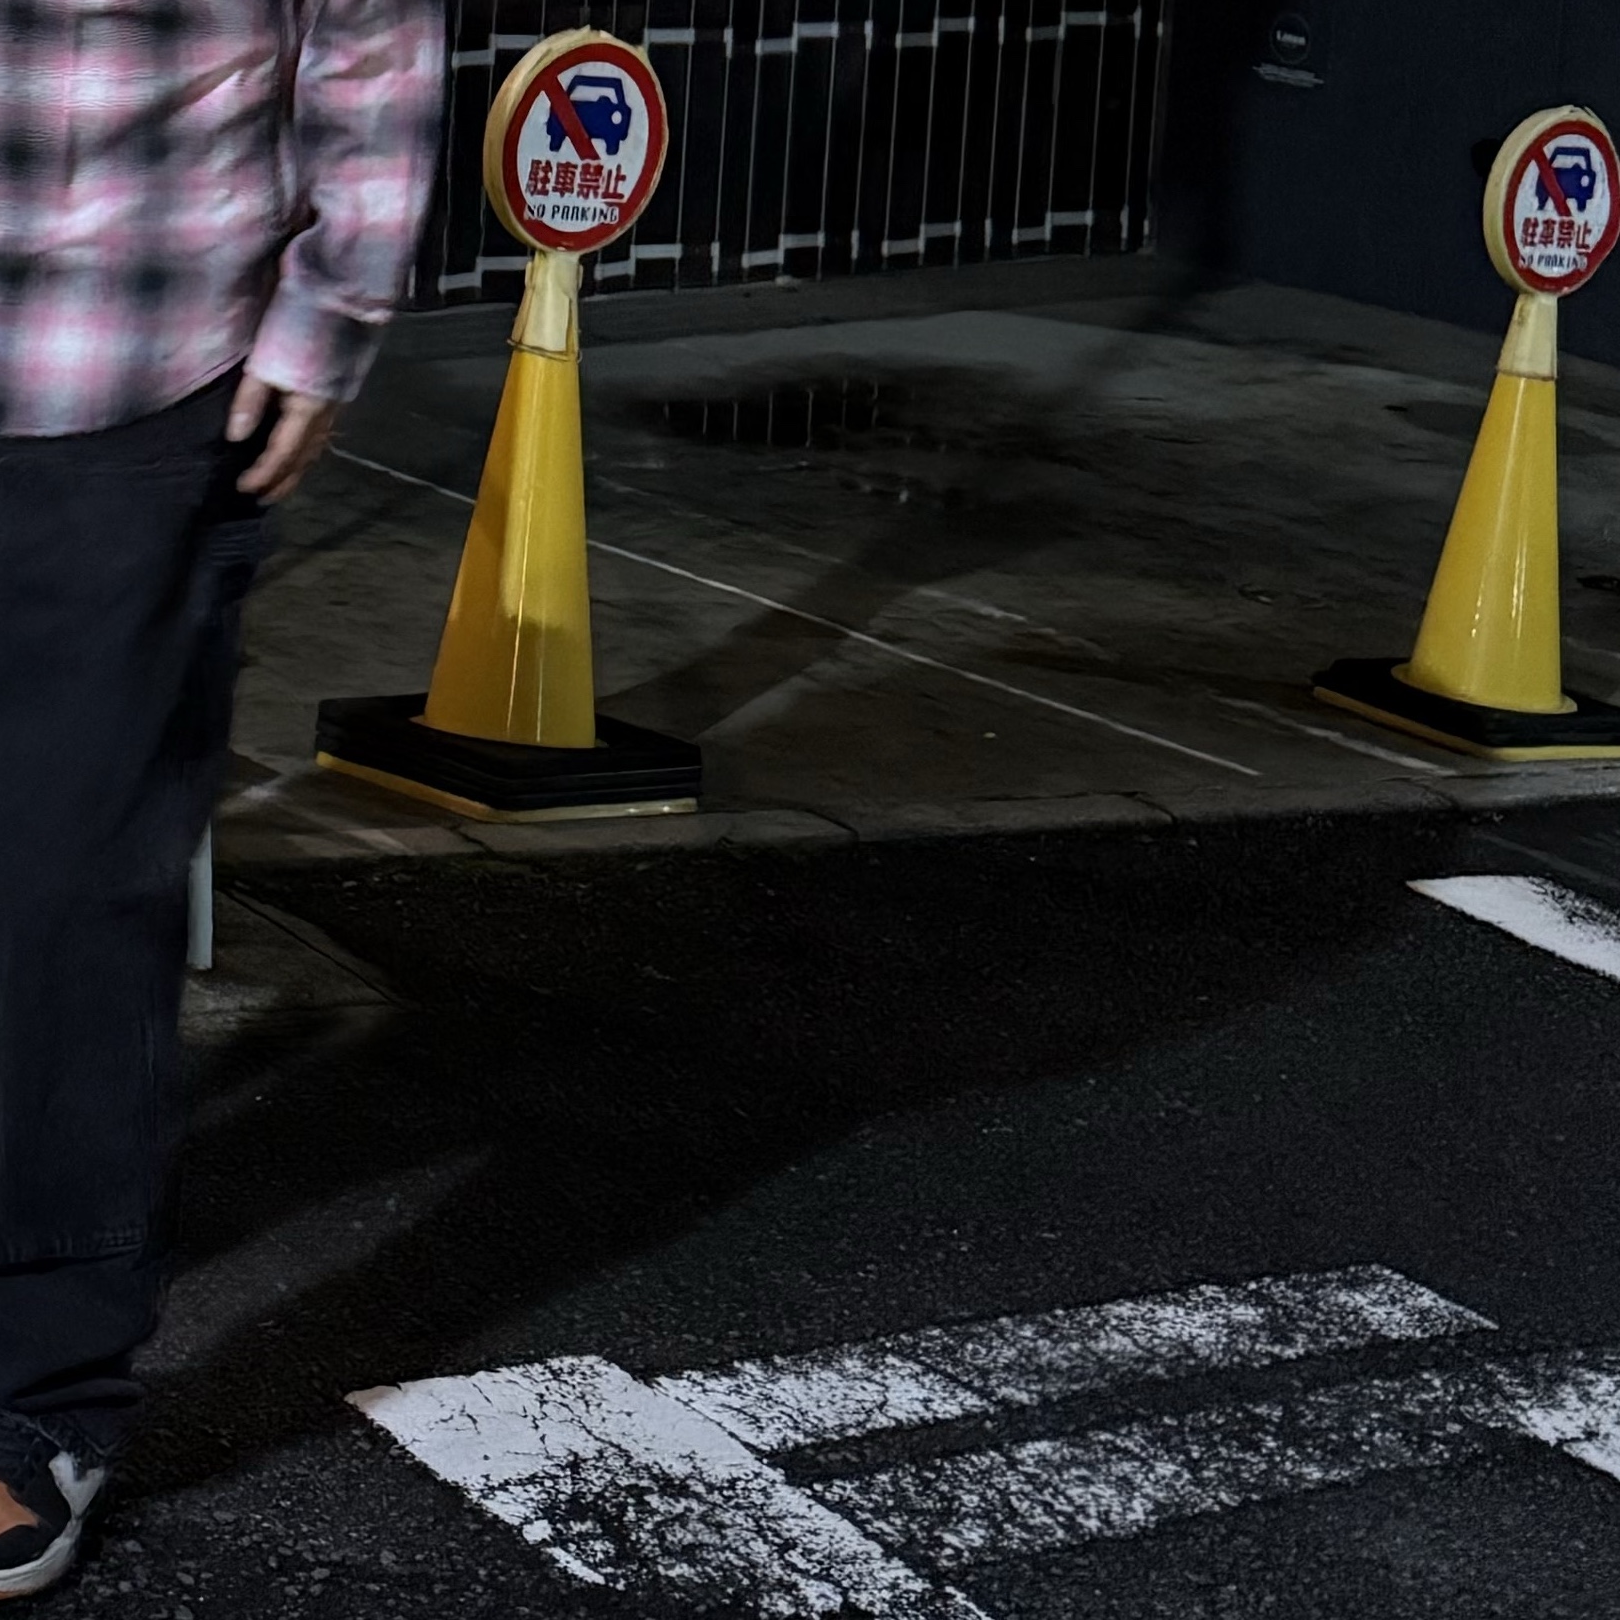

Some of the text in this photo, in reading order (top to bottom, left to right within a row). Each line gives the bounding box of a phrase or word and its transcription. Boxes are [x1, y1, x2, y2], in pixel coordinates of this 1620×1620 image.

[526, 159, 627, 199] 駐車禁止
[527, 204, 618, 222] NO PARKING
[1521, 217, 1592, 250] 駐車禁止
